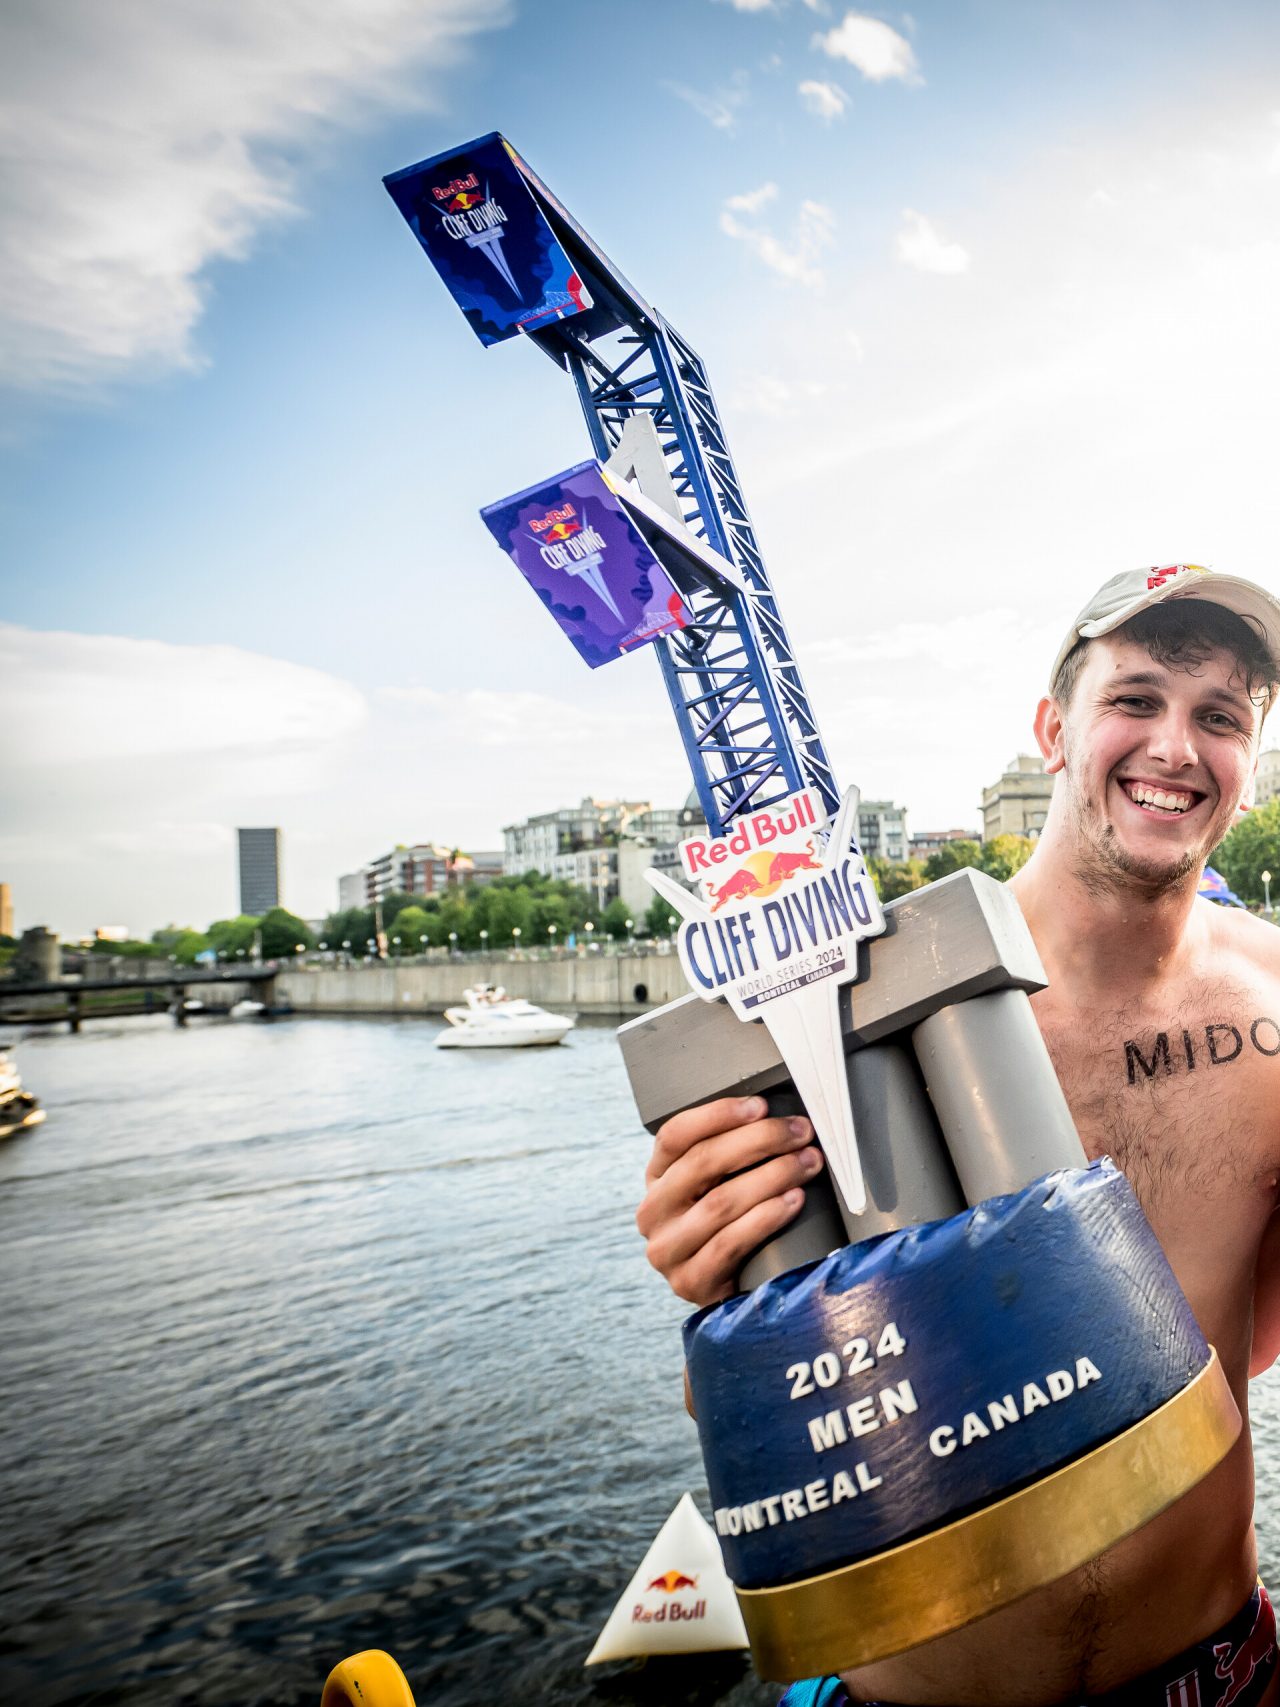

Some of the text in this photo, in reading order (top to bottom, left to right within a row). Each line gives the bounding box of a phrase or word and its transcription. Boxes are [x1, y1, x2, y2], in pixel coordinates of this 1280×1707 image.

[432, 173, 479, 200] Red Bull
[467, 198, 508, 231] DIVING
[528, 503, 576, 533] Red Bull
[565, 525, 607, 560] DIVING
[685, 794, 816, 873] Red Bull
[685, 859, 872, 990] CLIFF DIVING
[737, 946, 843, 998] WORLD SERIES 2024
[756, 980, 802, 1003] MONTREAL
[785, 1322, 906, 1400] 2024
[807, 1379, 919, 1454] MEN
[928, 1356, 1103, 1458] CANADA
[632, 1599, 706, 1624] Red Bull
